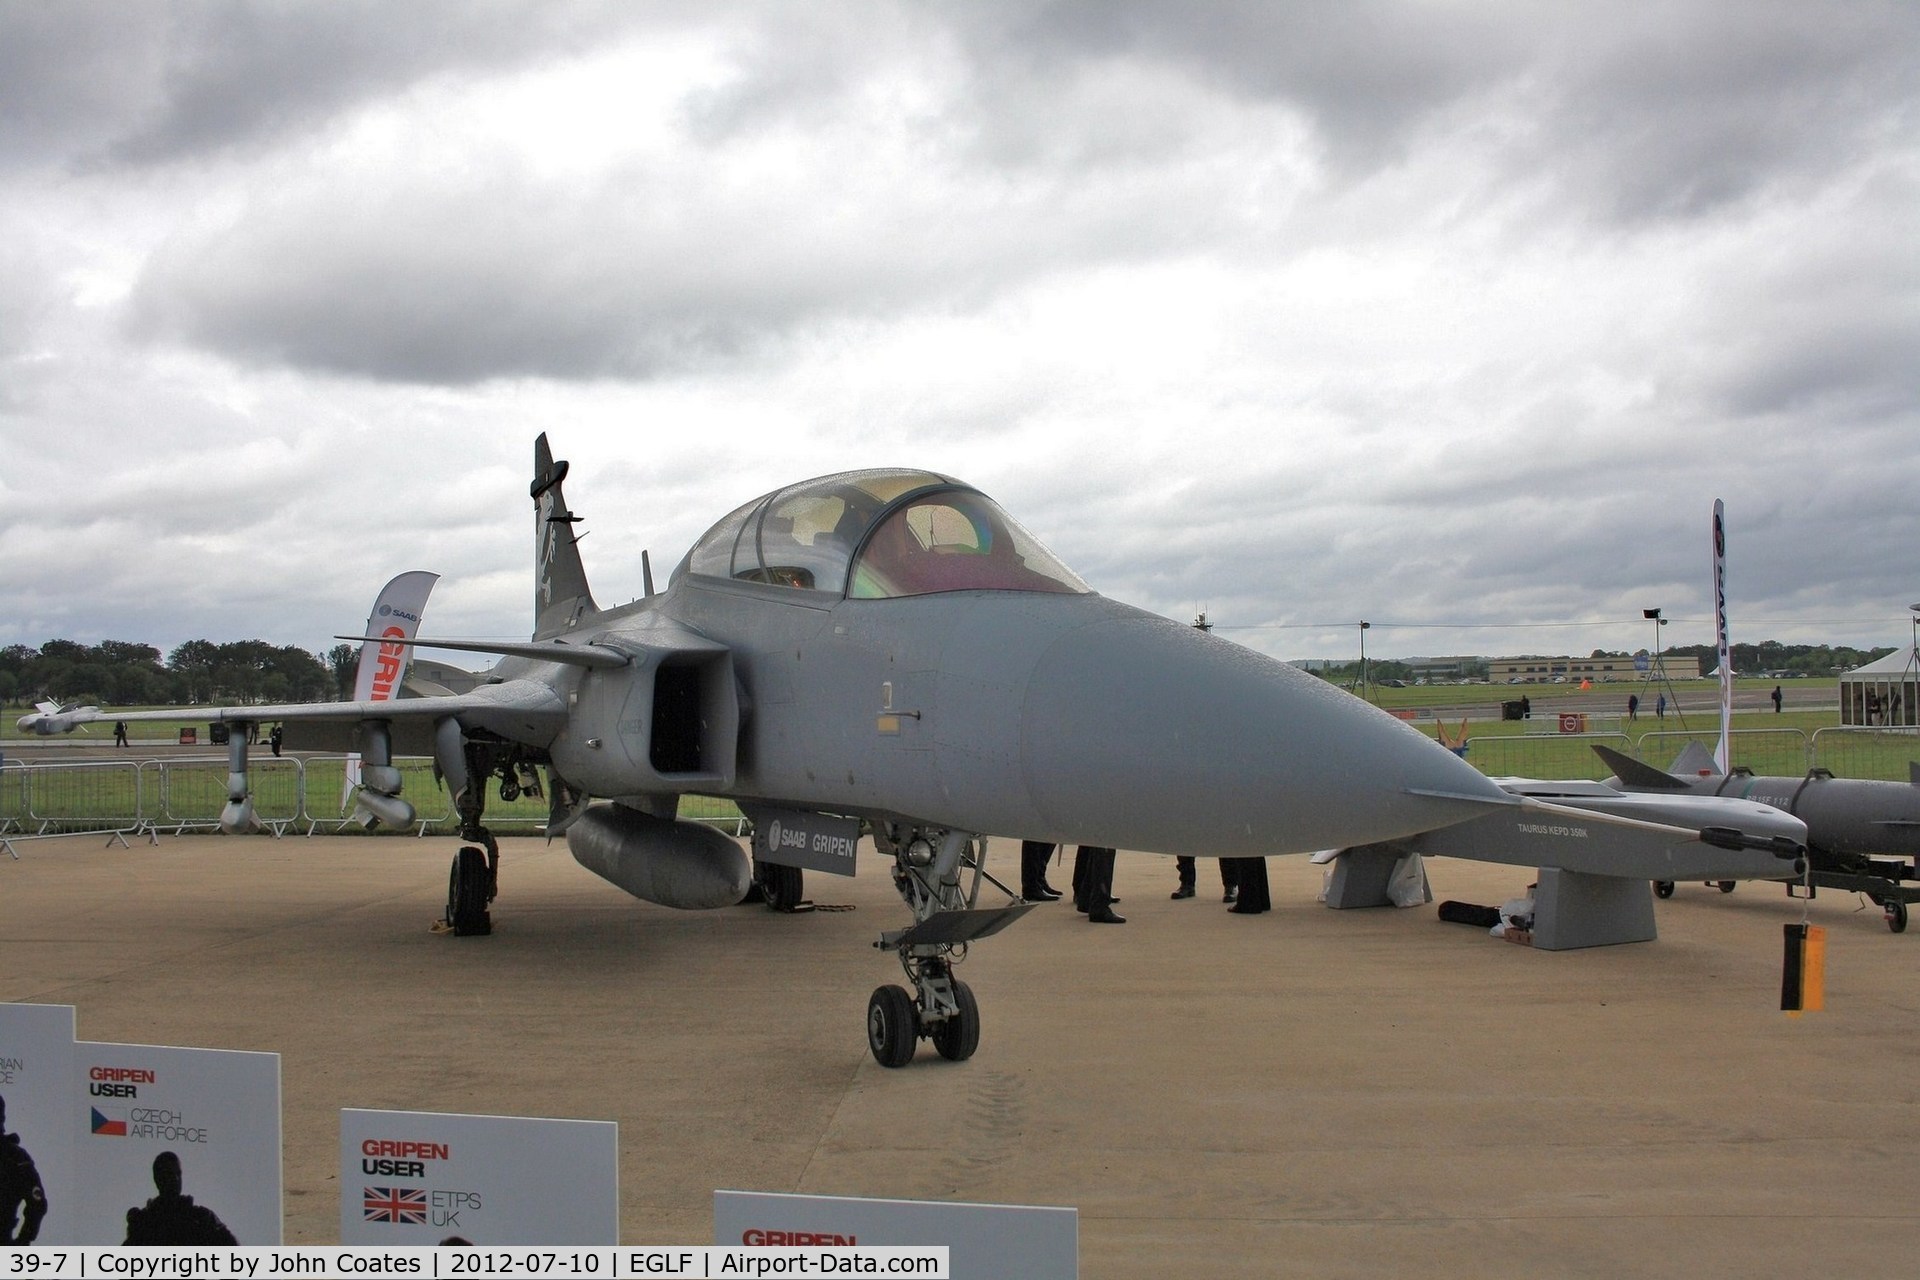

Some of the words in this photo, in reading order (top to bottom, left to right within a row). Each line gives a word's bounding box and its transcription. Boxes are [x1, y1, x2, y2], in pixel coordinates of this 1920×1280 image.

[392, 609, 418, 622] SAAB
[370, 626, 405, 701] GRI
[1518, 823, 1548, 834] TAURUS
[1548, 826, 1569, 836] KEPD
[781, 828, 806, 849] SAAB
[812, 833, 854, 858] GRIPEN
[89, 1066, 155, 1083] GRIPEN
[89, 1082, 138, 1099] USER
[130, 1107, 182, 1125] CZECH
[130, 1124, 154, 1139] AIR
[156, 1125, 208, 1143] FORCE
[361, 1139, 449, 1160] GRIPEN
[362, 1158, 425, 1178] USER
[432, 1190, 482, 1210] ETPS
[432, 1210, 460, 1228] UK
[742, 1229, 856, 1247] GRIPEN
